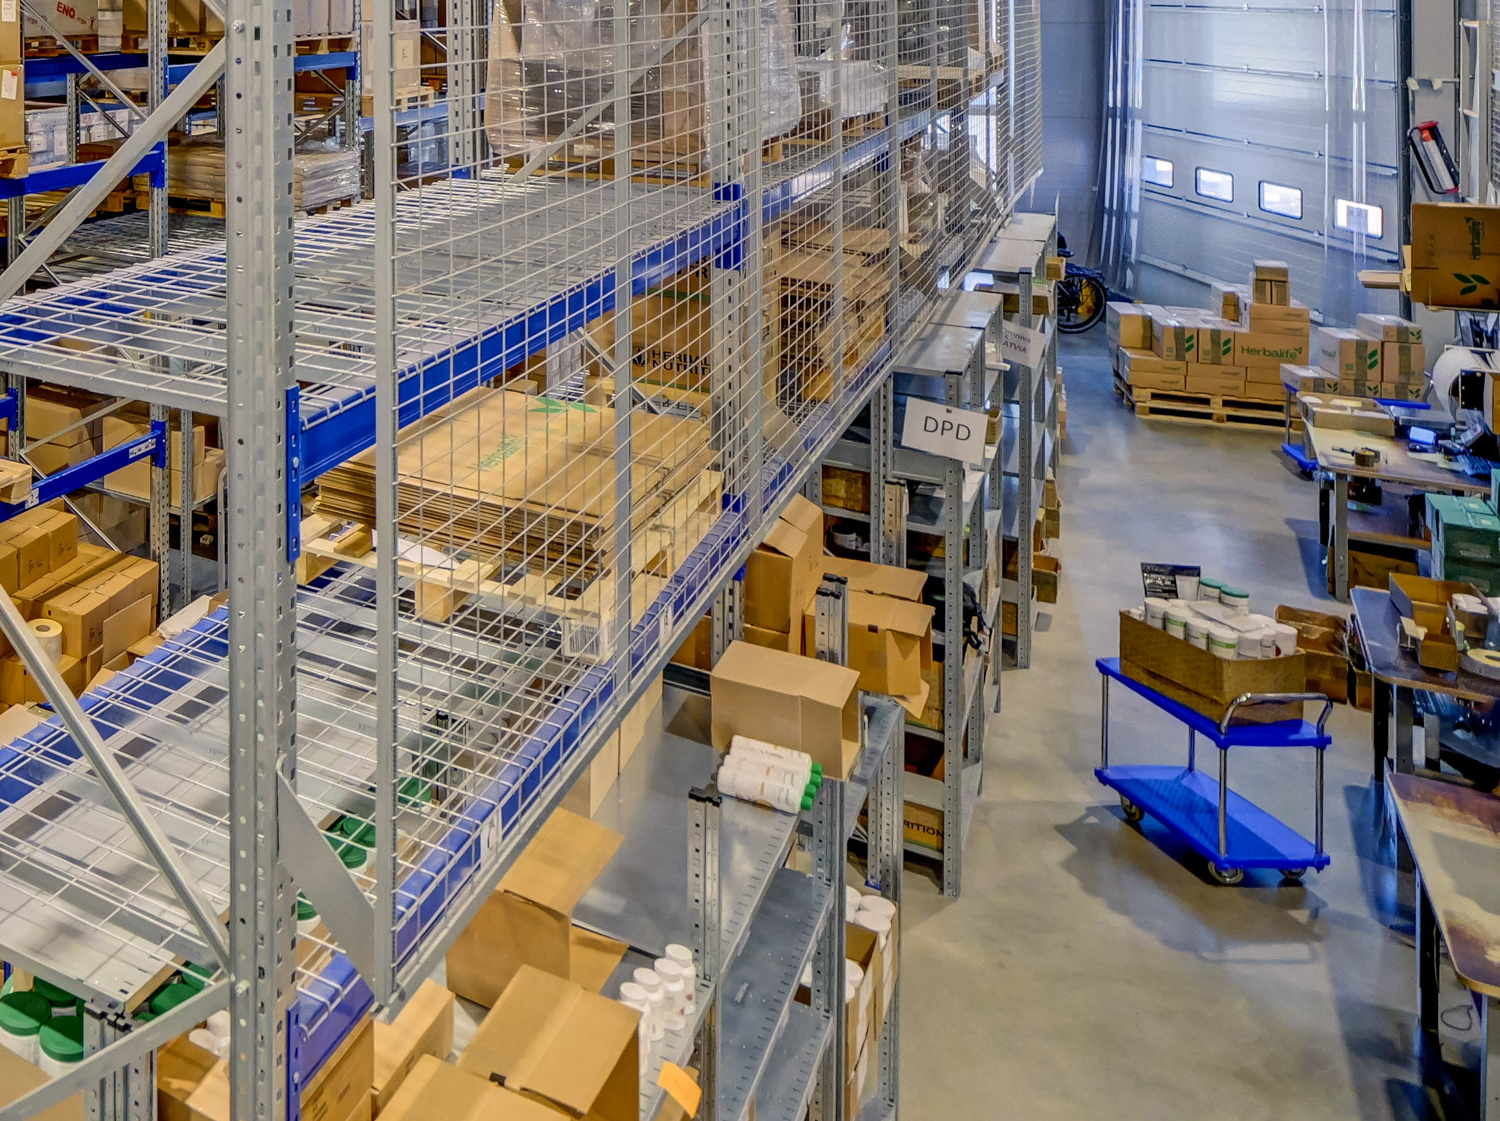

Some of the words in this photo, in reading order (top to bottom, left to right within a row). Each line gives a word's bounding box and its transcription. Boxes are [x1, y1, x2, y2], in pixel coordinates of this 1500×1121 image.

[56, 1, 76, 20] ENO
[1002, 340, 1027, 354] ATVIA
[1240, 345, 1298, 360] Herbalife
[652, 349, 711, 367] HERBAL
[652, 360, 711, 376] NUTRIT
[923, 415, 971, 441] DPD
[904, 820, 944, 839] RITION
